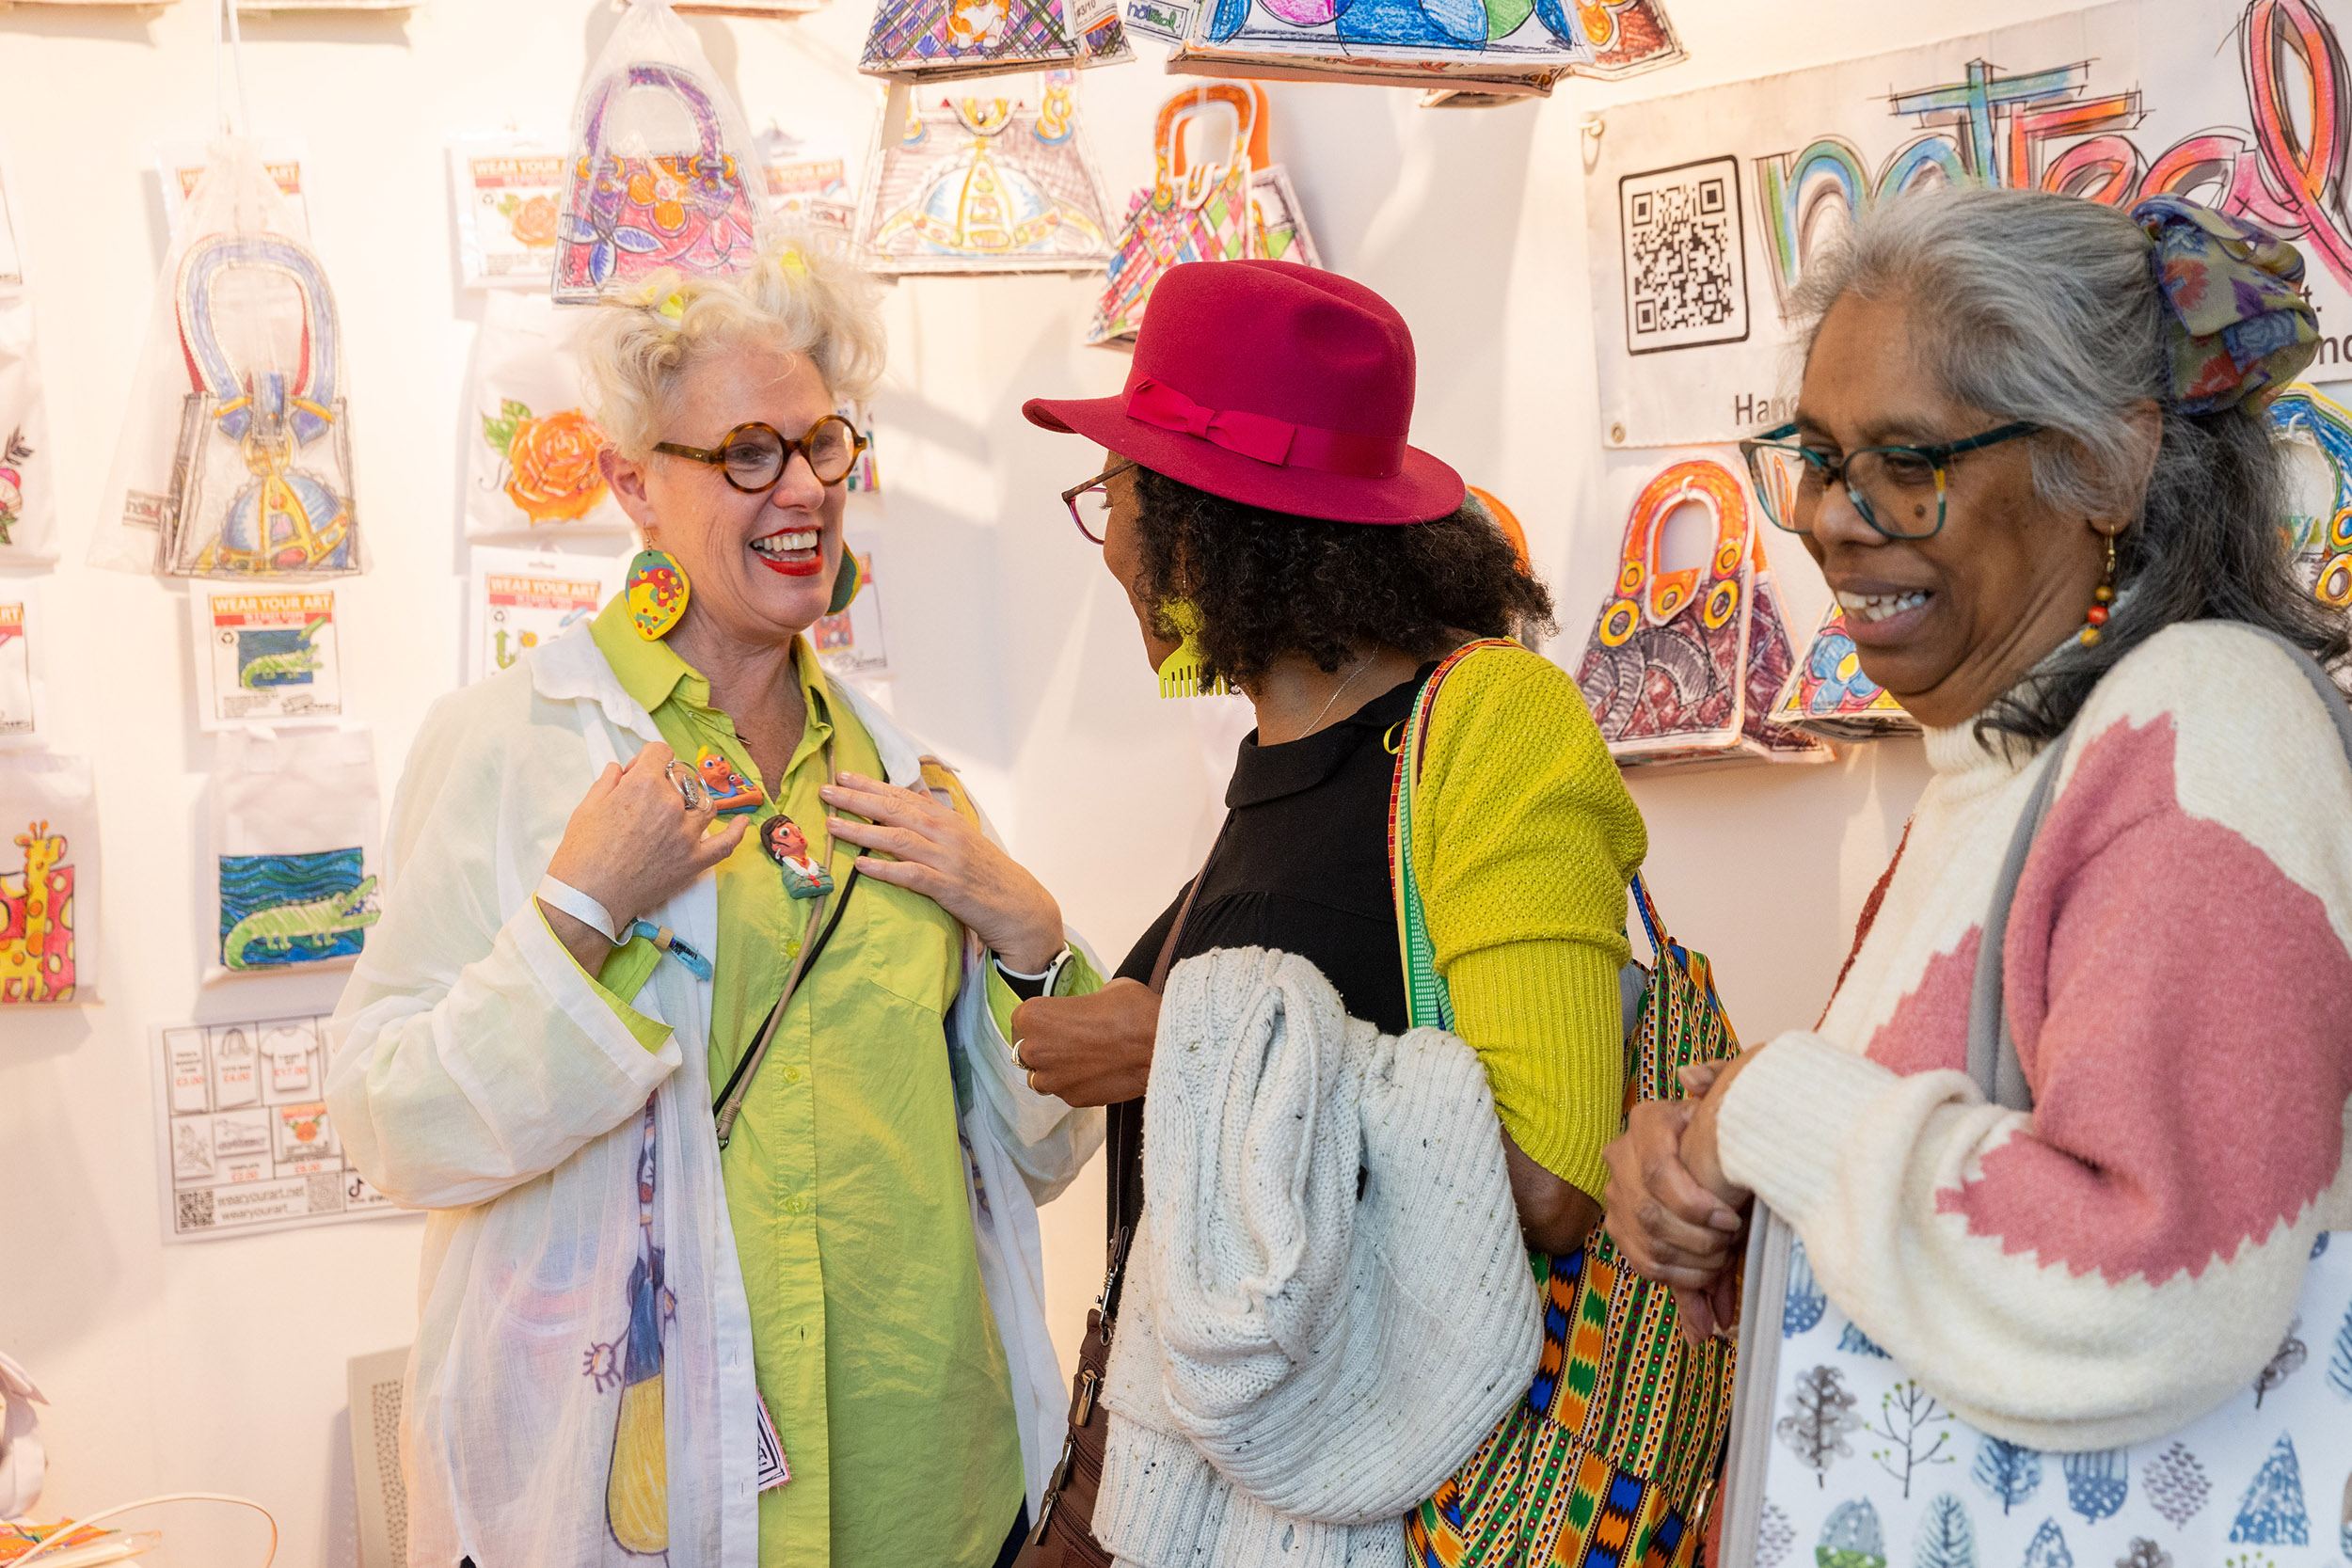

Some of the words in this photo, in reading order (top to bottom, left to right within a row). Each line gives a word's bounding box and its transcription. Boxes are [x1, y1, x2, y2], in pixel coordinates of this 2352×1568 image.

[490, 577, 531, 593] WEAR
[533, 579, 568, 595] YOUR
[571, 582, 597, 597] ART
[215, 596, 257, 611] WEAR
[260, 595, 300, 610] YOUR
[304, 594, 330, 610] ART
[0, 608, 20, 623] RT
